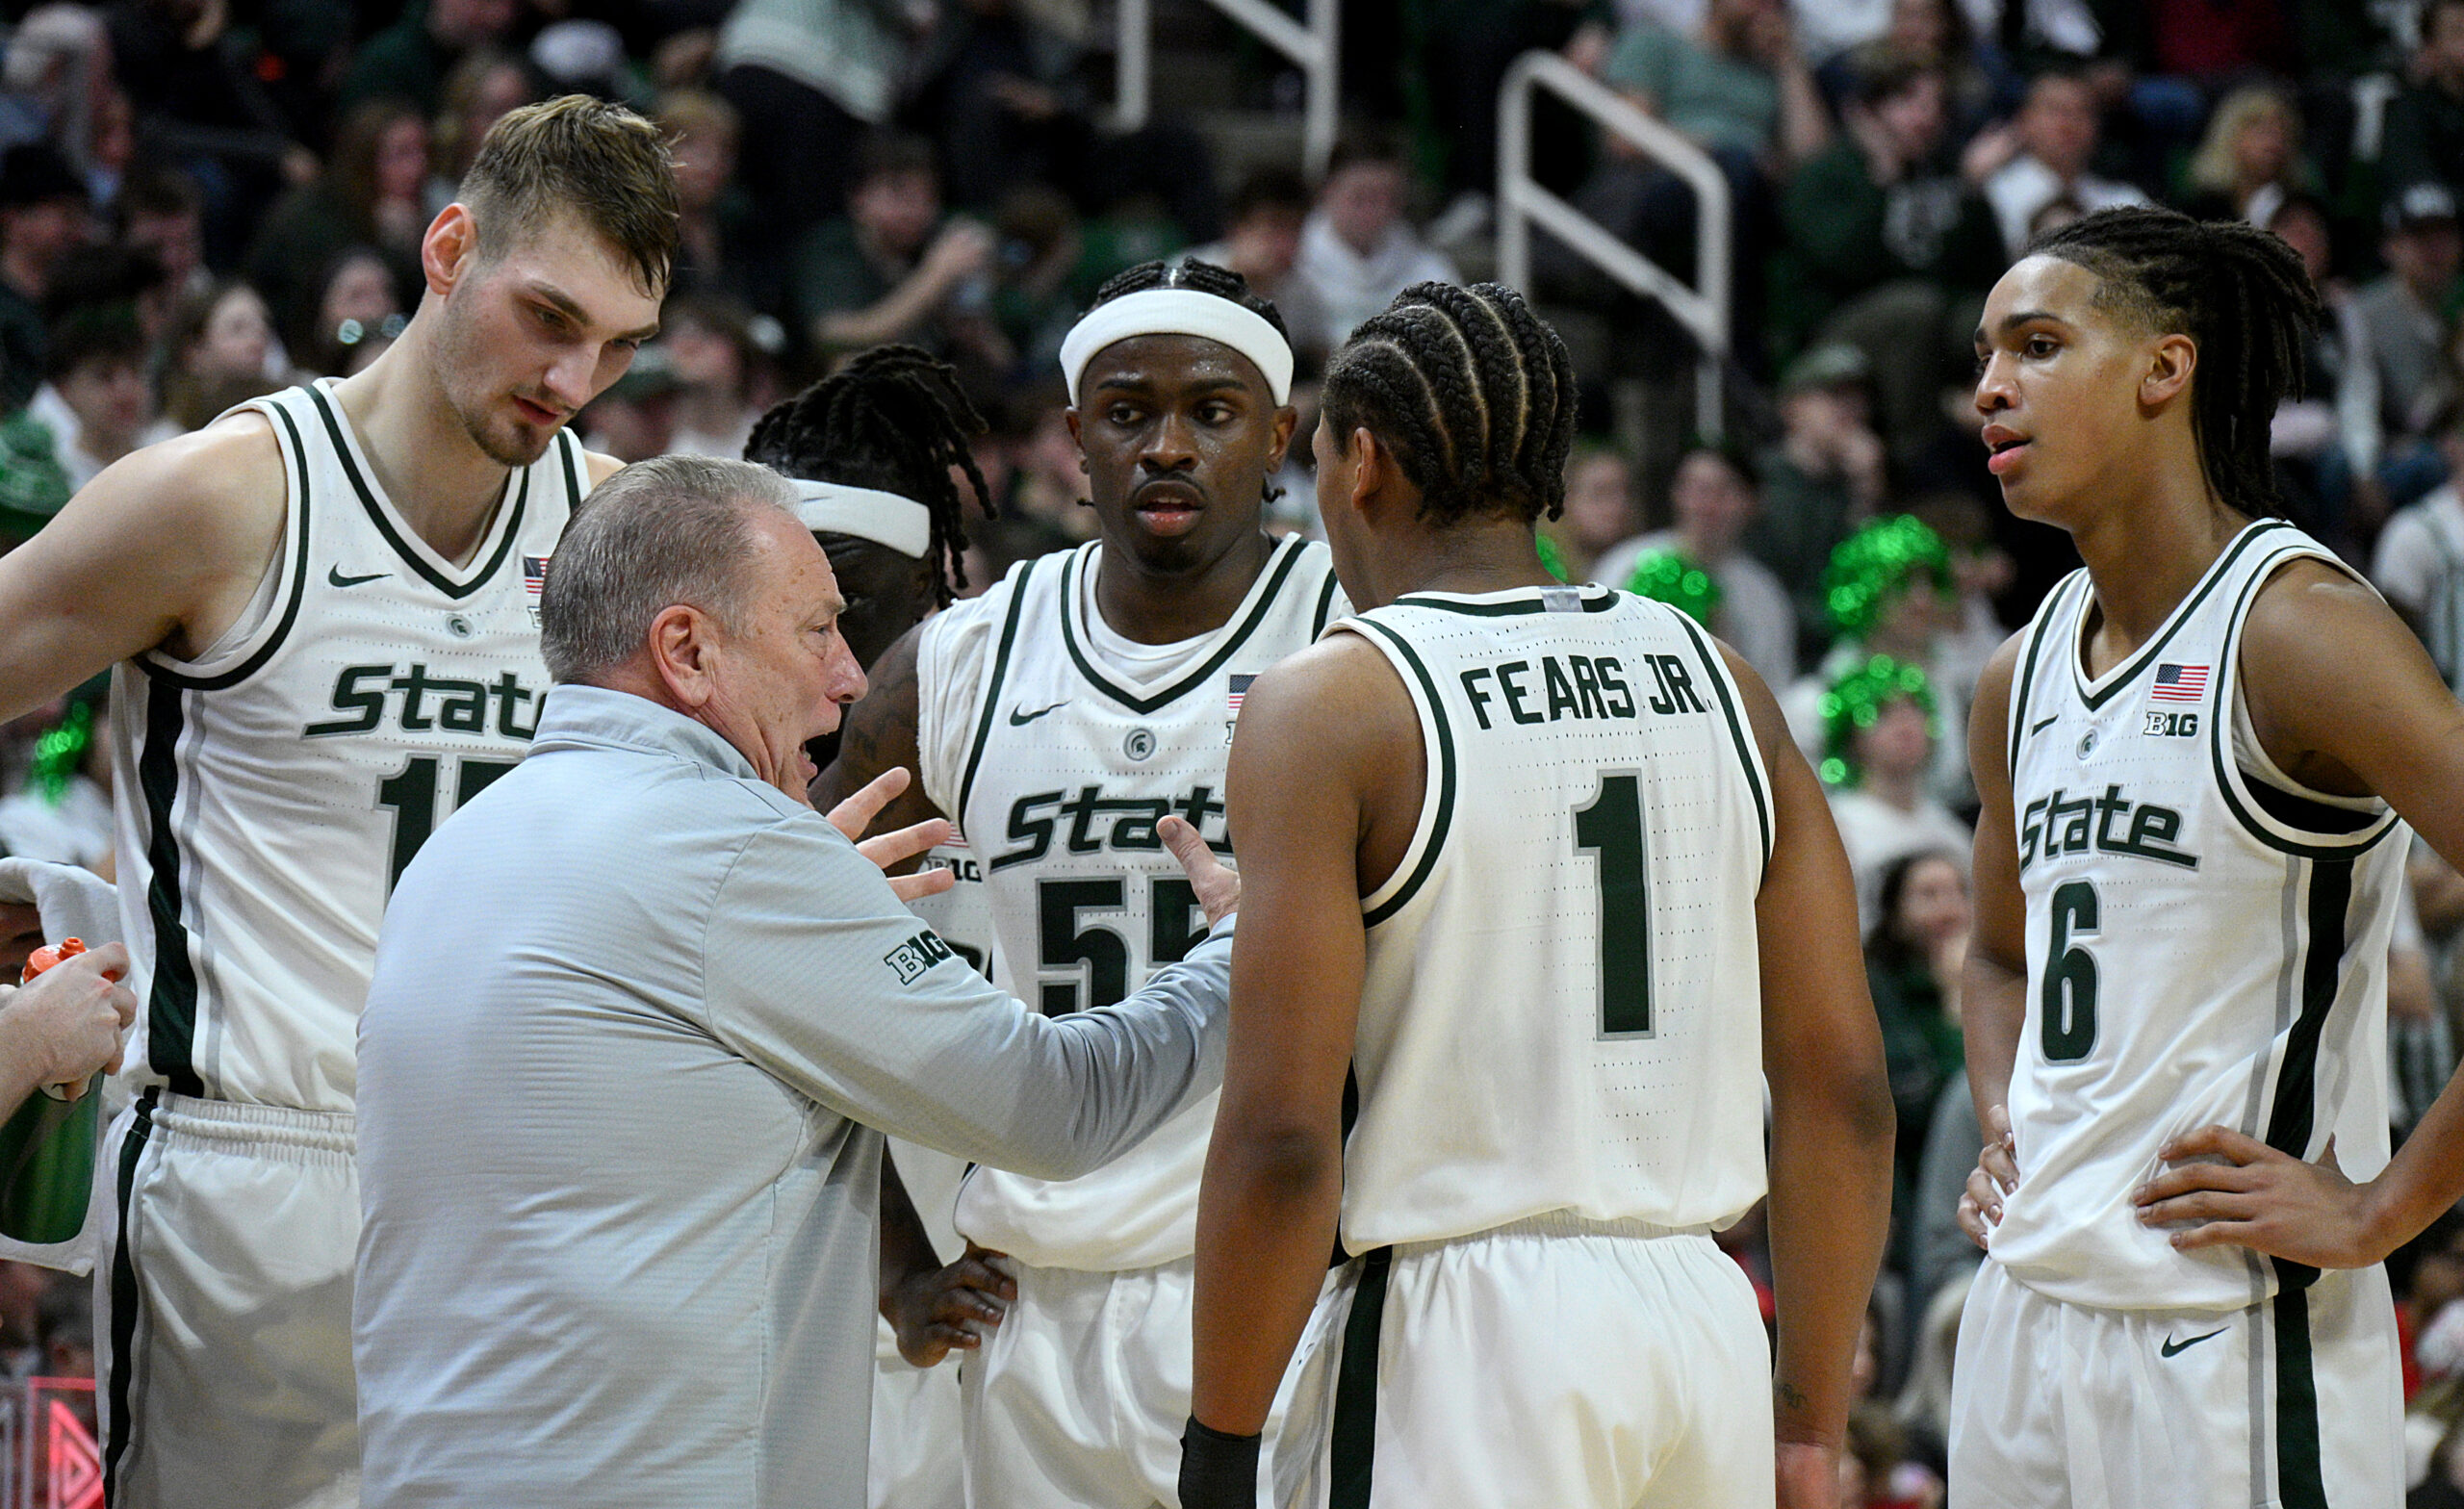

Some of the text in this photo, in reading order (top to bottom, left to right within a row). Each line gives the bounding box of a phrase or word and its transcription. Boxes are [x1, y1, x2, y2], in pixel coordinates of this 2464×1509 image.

[300, 661, 547, 741] Stat
[1459, 654, 1713, 729] FEARS JR.
[373, 753, 526, 914] 1
[989, 784, 1235, 874] Stat
[2020, 783, 2201, 873] State
[1570, 768, 1656, 1041] 1
[2040, 877, 2101, 1065] 6
